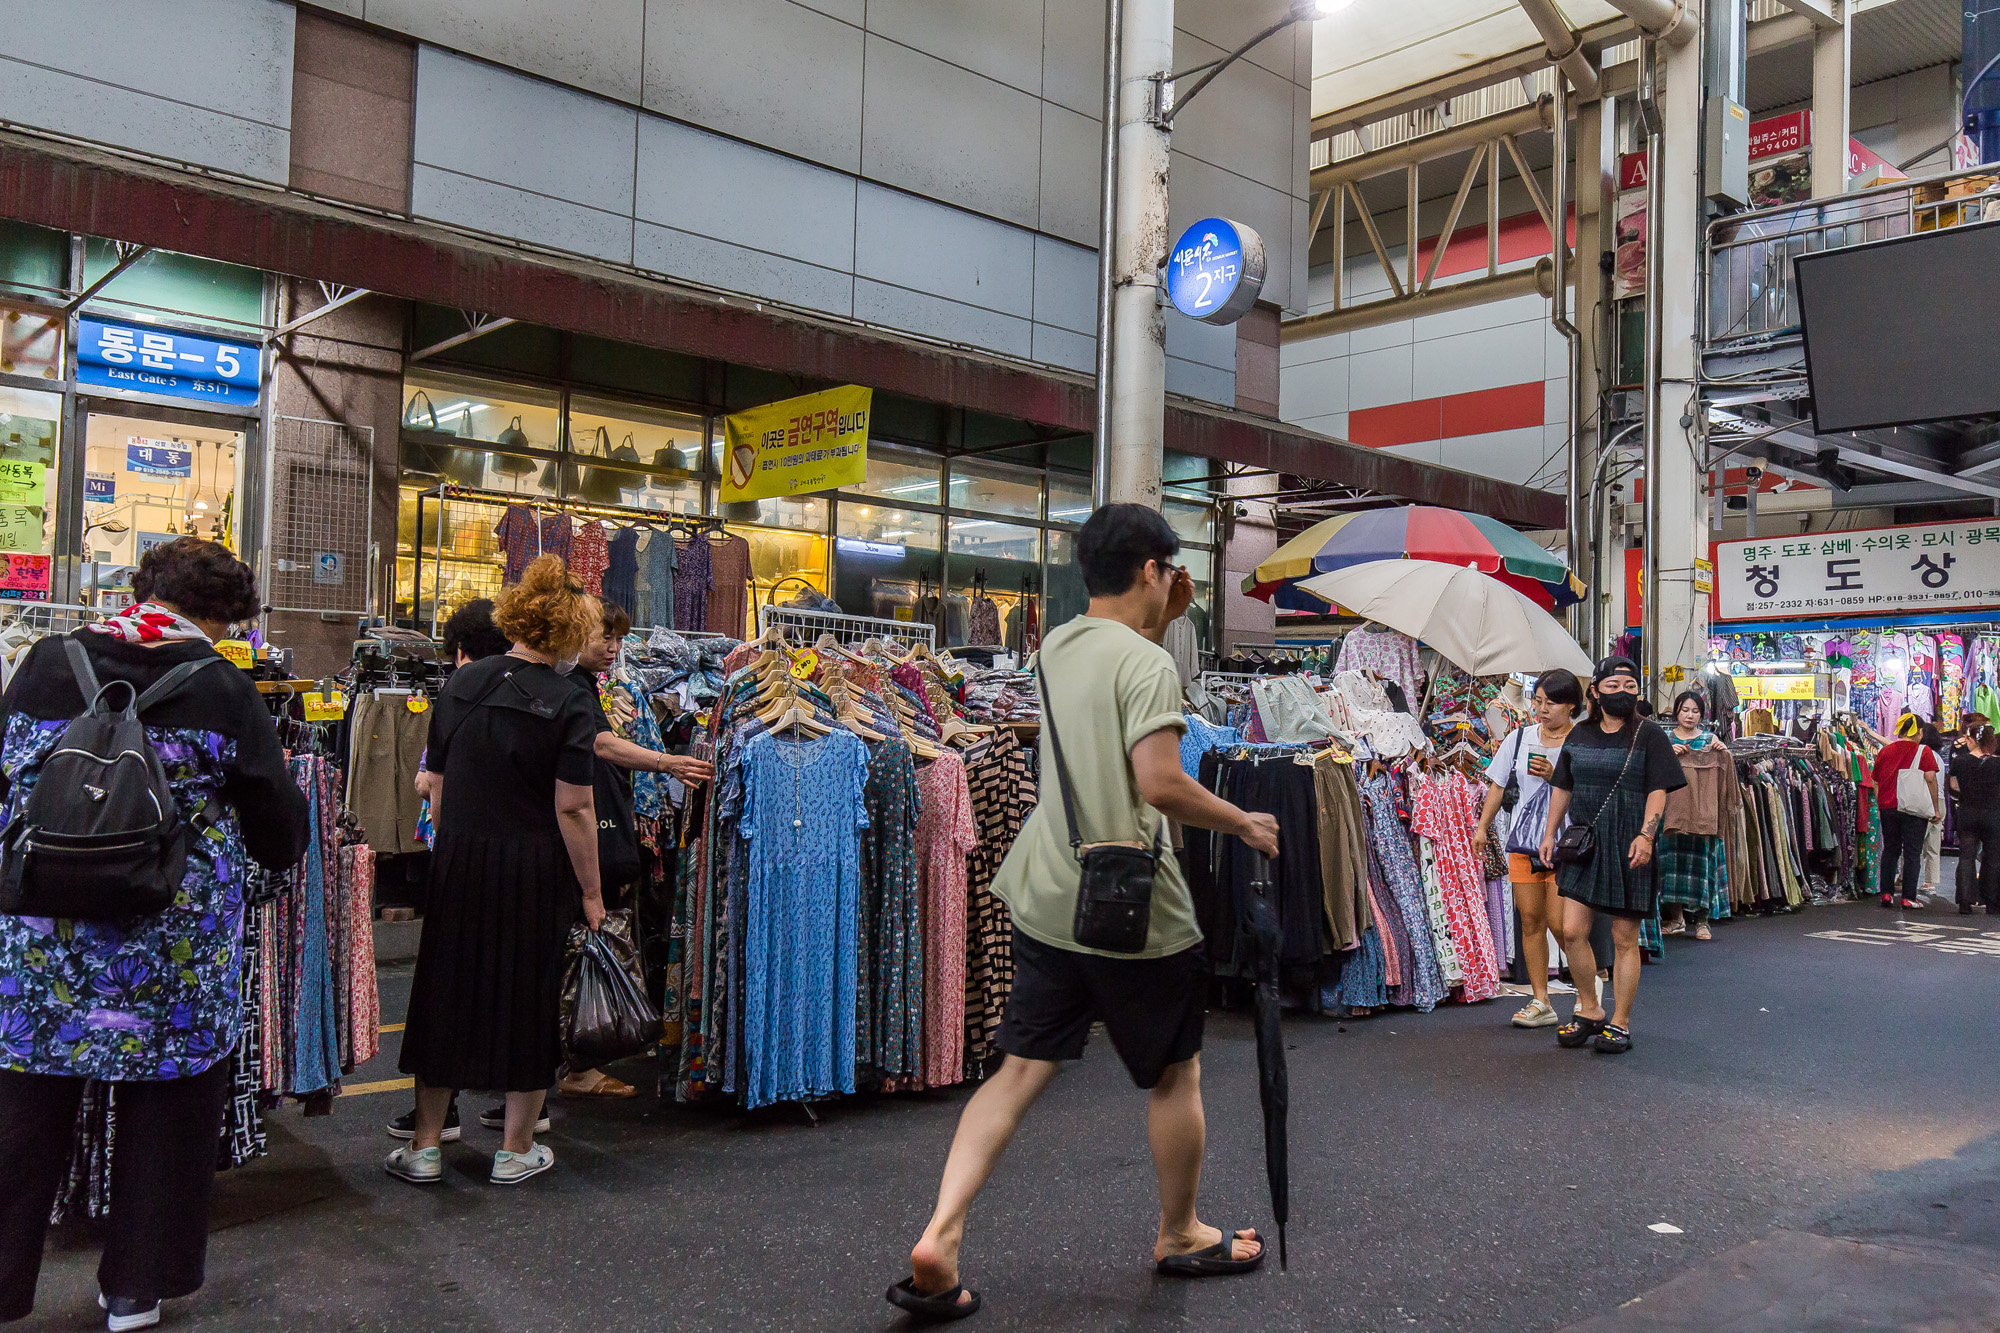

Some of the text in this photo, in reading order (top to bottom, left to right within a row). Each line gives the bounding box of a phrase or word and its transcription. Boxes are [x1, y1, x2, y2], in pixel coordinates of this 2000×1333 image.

[1174, 242, 1212, 277] 서문시장
[1194, 264, 1237, 308] 2 지구
[108, 367, 177, 387] East Gate 5
[761, 407, 866, 450] 이곳은 금연구역입니다
[90, 481, 106, 492] Mi
[1965, 526, 2000, 545] 광목
[213, 646, 250, 661] 천원
